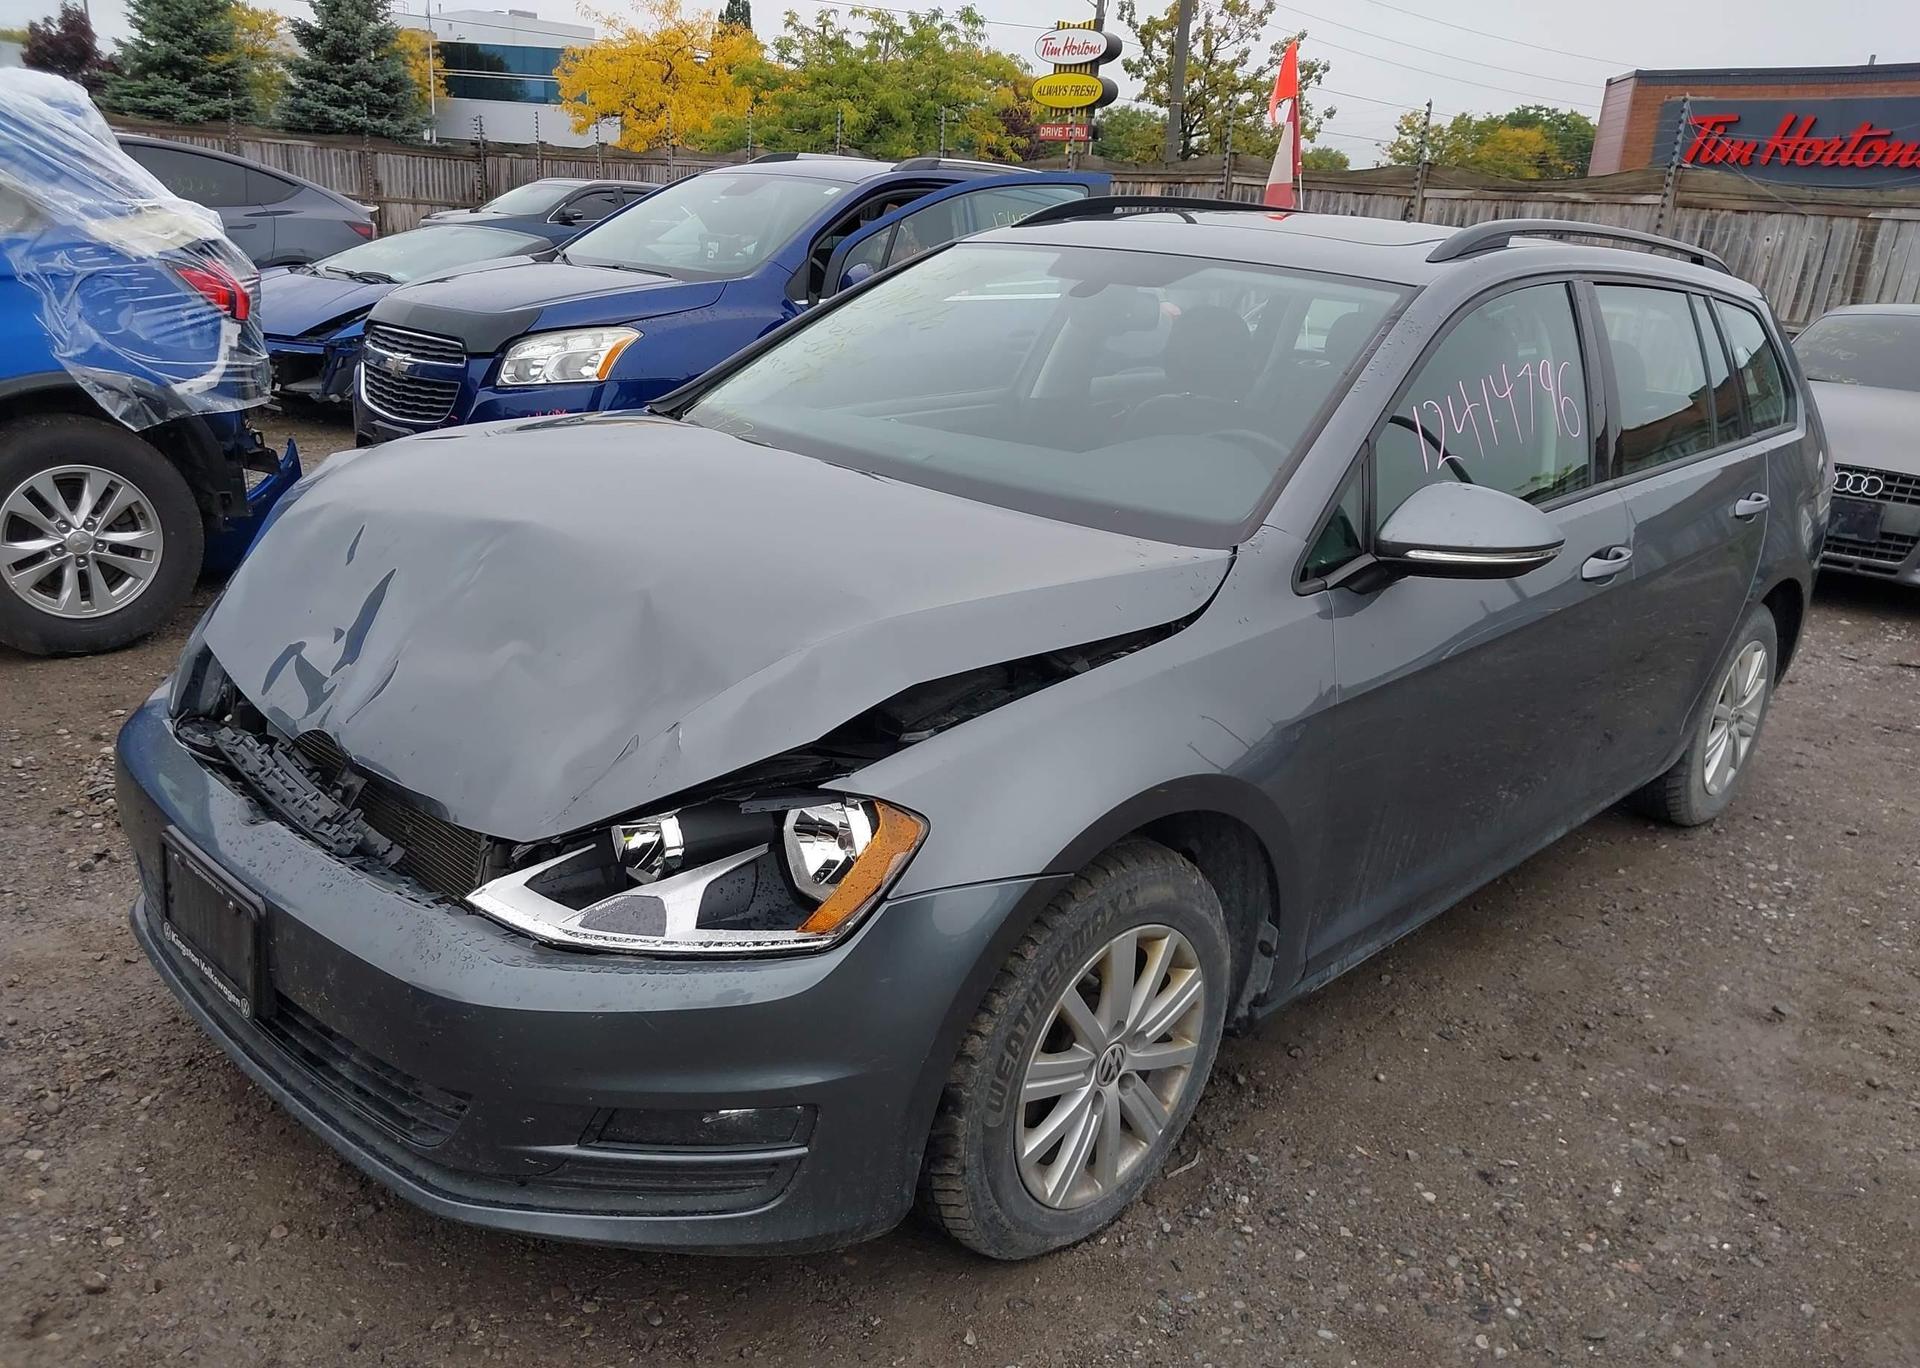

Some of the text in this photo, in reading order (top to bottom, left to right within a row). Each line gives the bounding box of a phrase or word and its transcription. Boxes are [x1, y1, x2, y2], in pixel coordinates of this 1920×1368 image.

[1042, 36, 1101, 57] Tim Hortons
[1037, 85, 1097, 97] ALWAYS FRESH
[1040, 126, 1087, 137] DRIVE TRU
[1681, 112, 1920, 168] Tim Horton
[1412, 359, 1581, 474] 12414796
[200, 958, 242, 1008] Volkswagen
